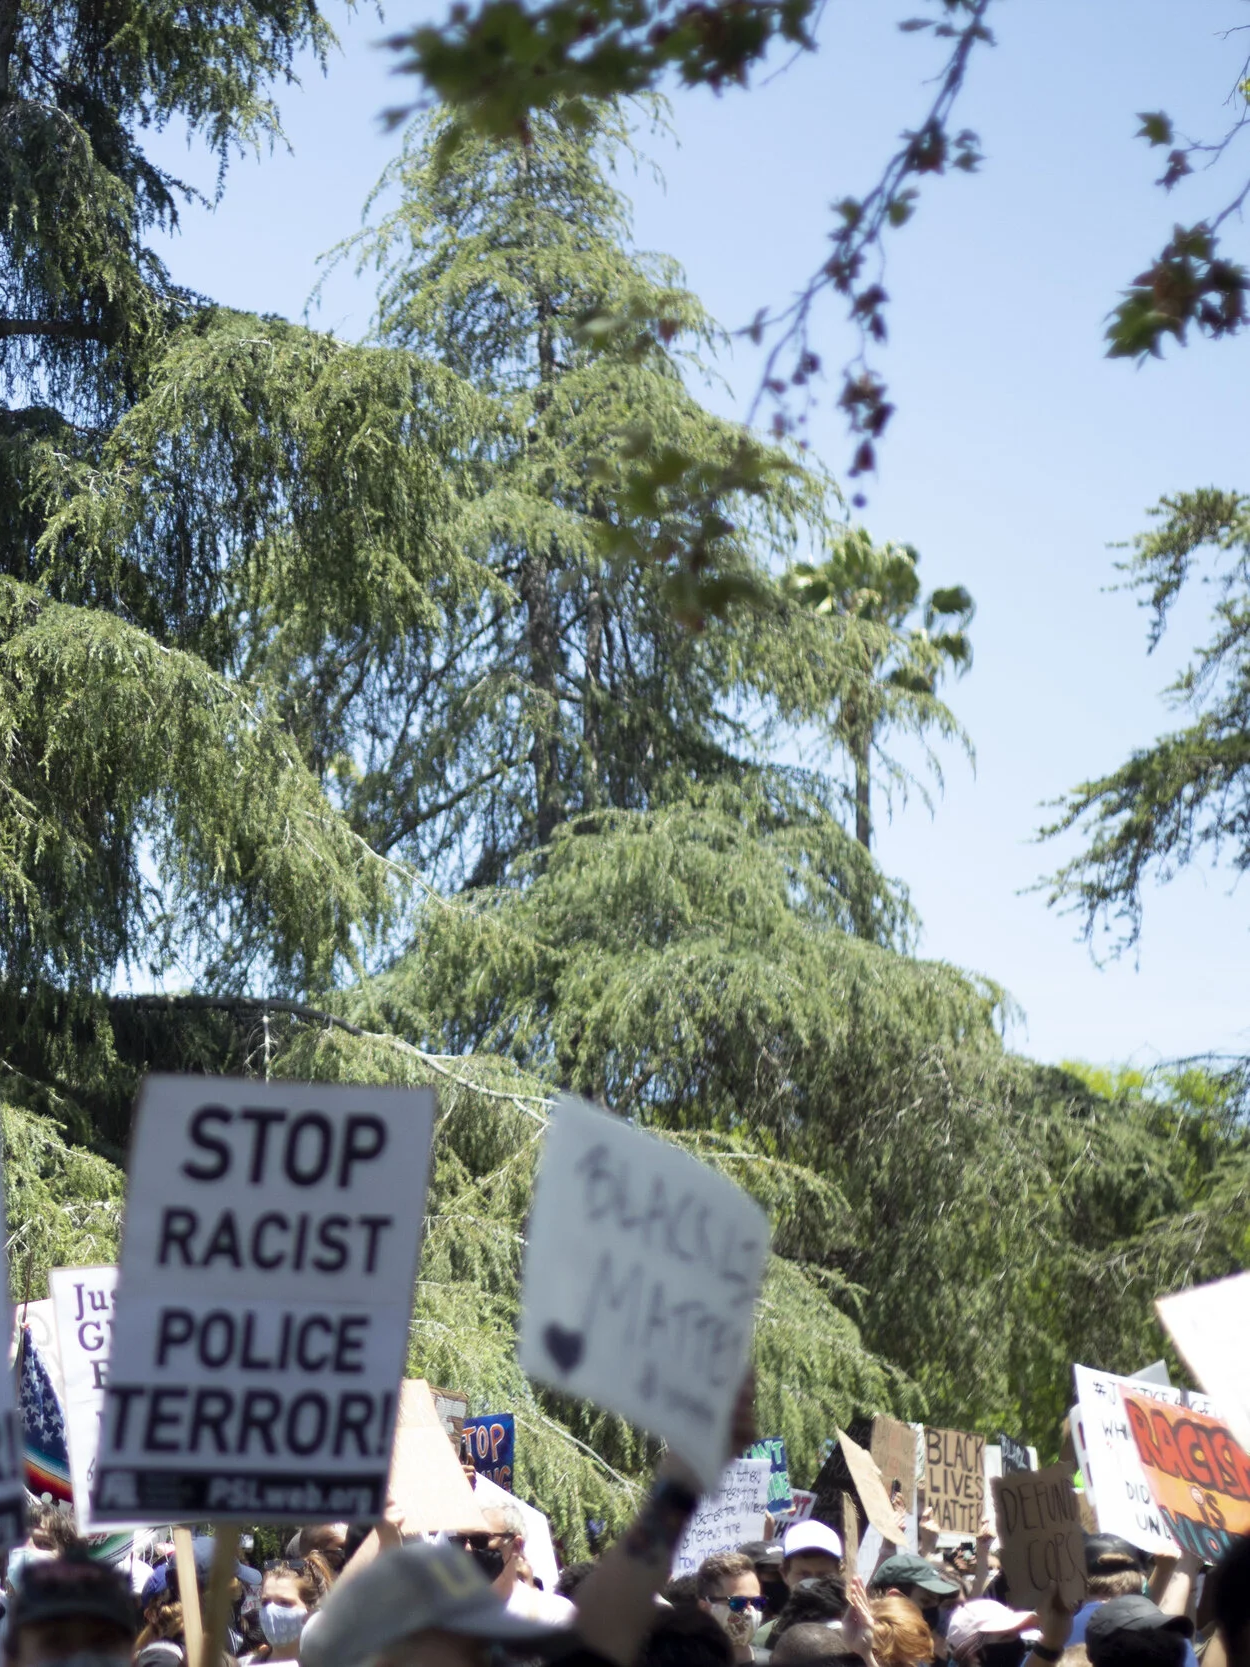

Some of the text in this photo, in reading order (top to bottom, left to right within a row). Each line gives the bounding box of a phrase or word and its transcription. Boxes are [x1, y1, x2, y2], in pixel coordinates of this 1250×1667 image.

[182, 1104, 389, 1189] STOP
[157, 1206, 393, 1277] RACIST
[155, 1305, 371, 1374] POLICE
[107, 1384, 397, 1459] TERROR!
[461, 1423, 505, 1462] TOP
[927, 1429, 985, 1476] BLACK
[930, 1467, 985, 1501] LIVES
[1001, 1479, 1078, 1536] DEFUND
[928, 1497, 984, 1533] MATTER
